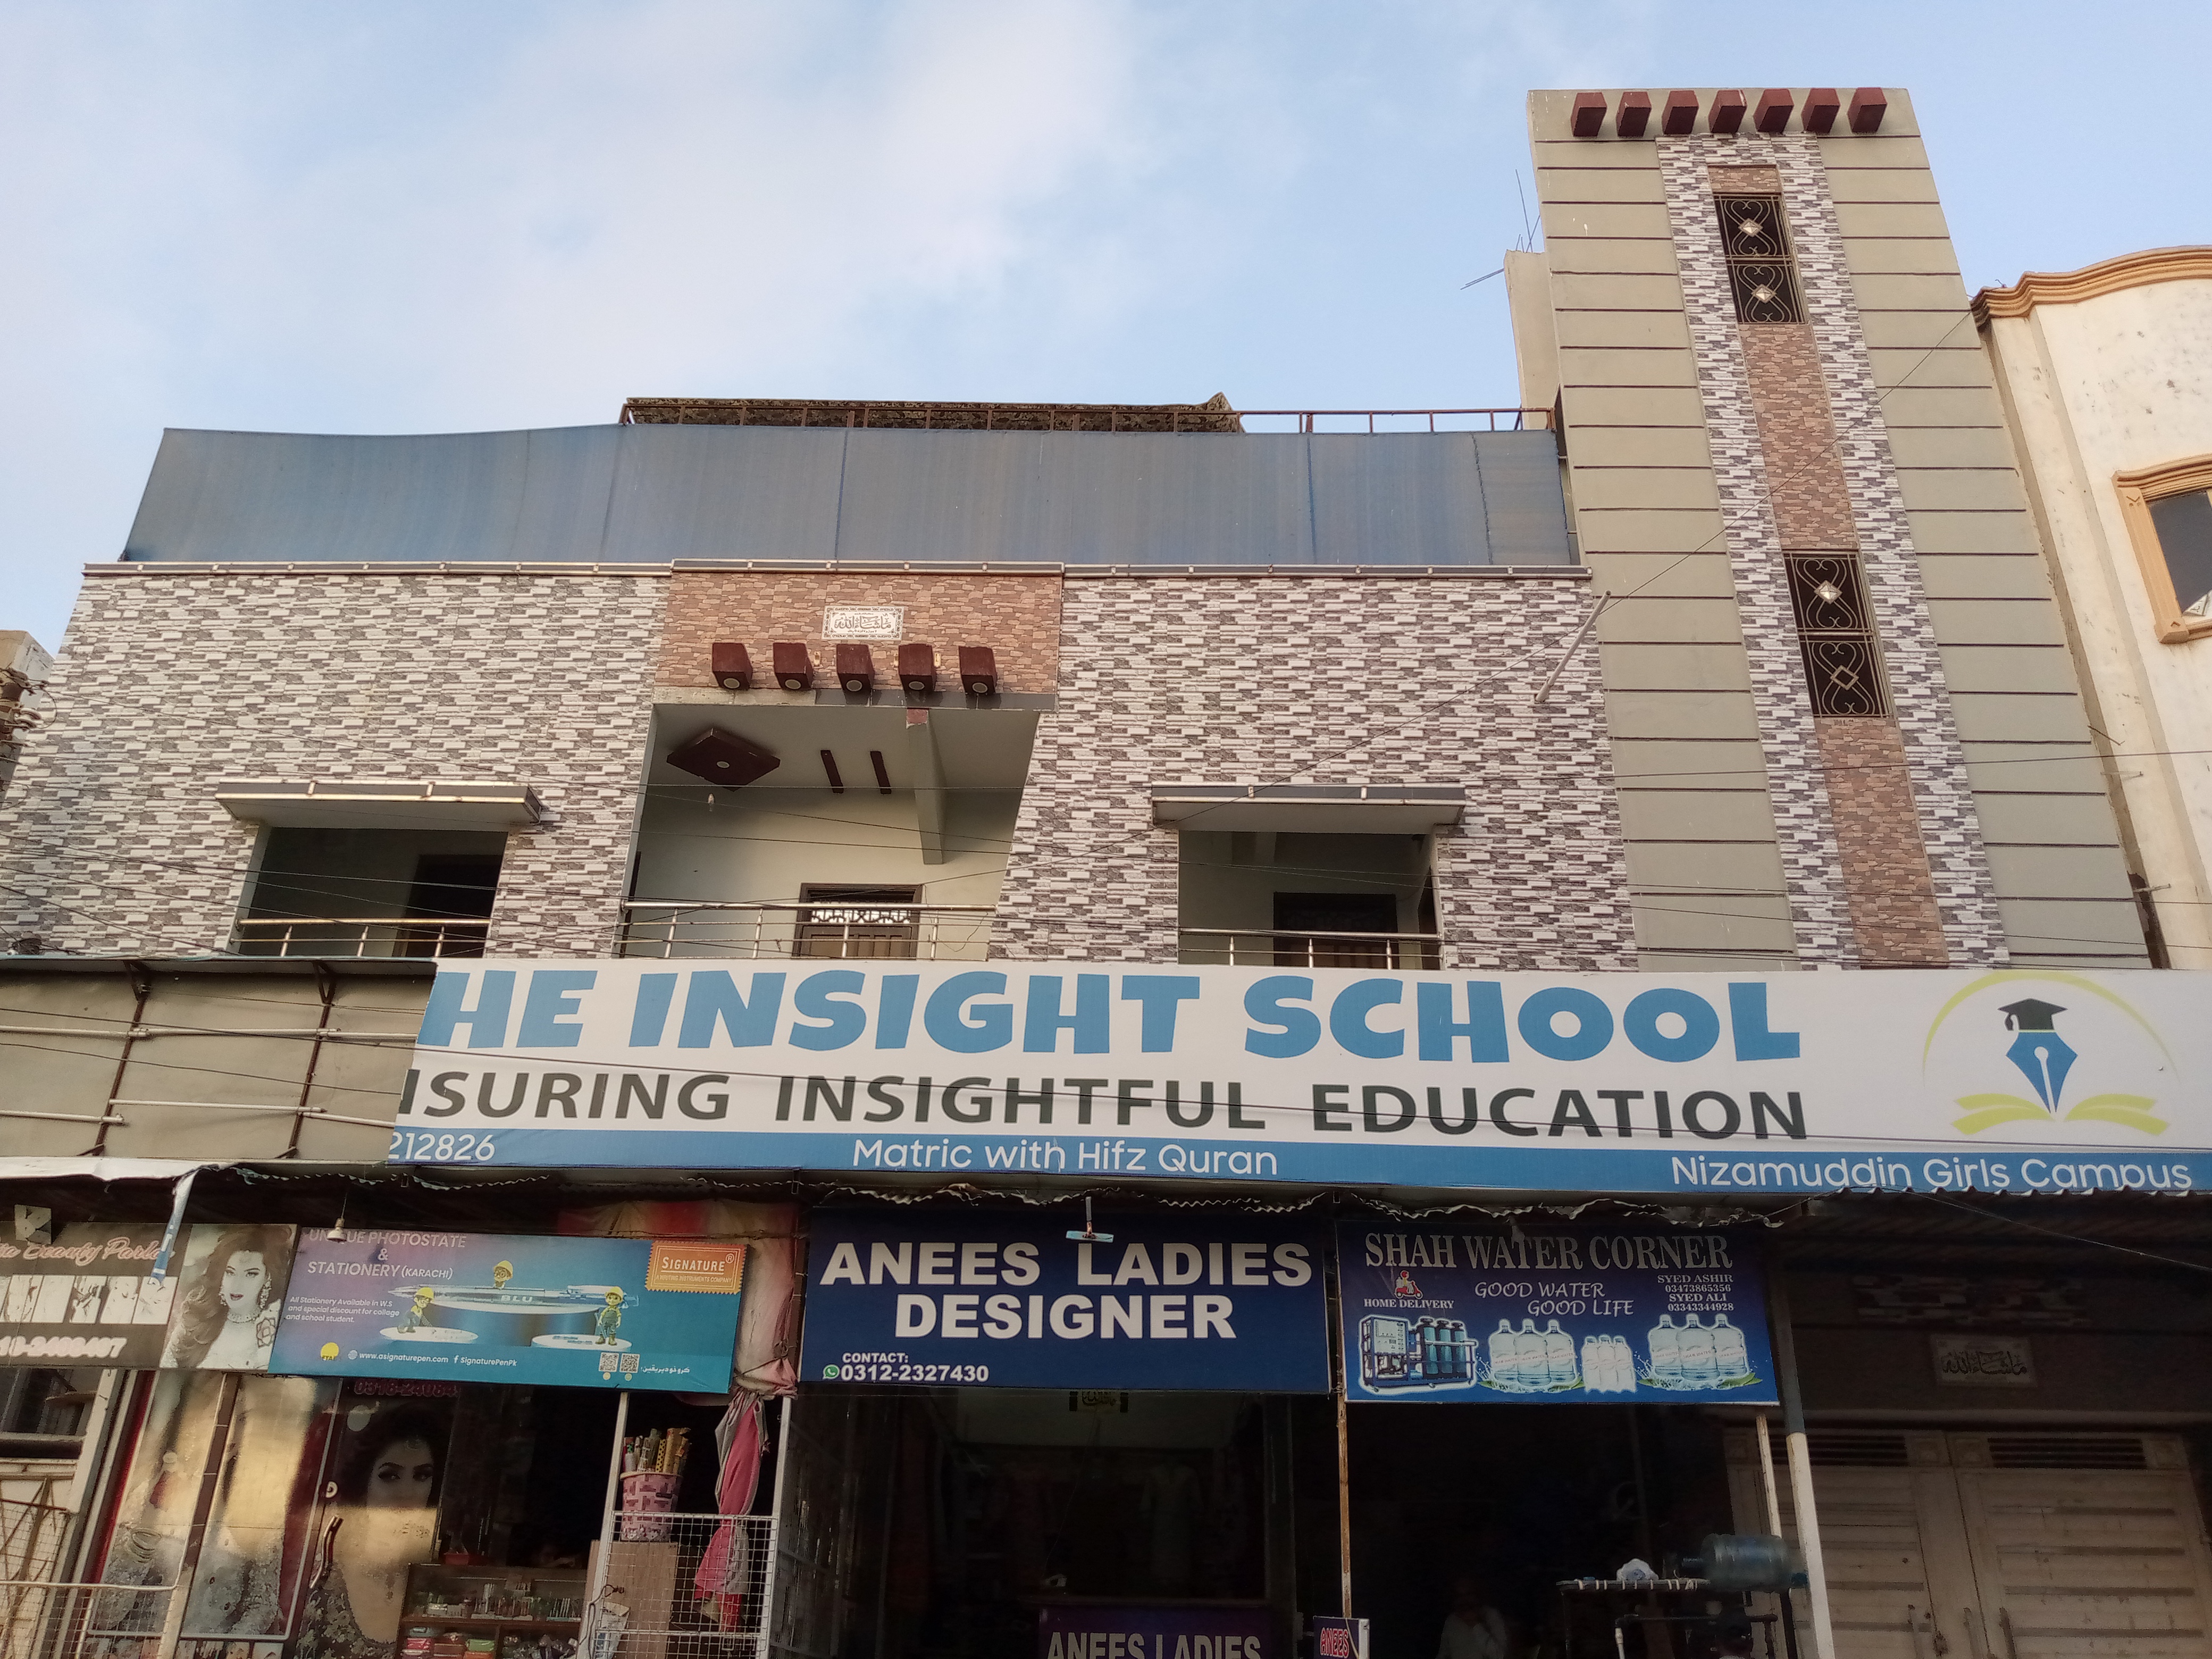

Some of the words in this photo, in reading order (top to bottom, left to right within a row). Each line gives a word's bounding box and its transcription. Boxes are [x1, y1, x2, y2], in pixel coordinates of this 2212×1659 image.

[629, 969, 1200, 1054] INSIGHT
[1243, 975, 1800, 1063] SCHOOL
[775, 1075, 1266, 1129] INSIGHTFUL
[1312, 1084, 1807, 1140] EDUCATION
[852, 1138, 973, 1169] Matric
[984, 1138, 1067, 1172] with
[1077, 1140, 1153, 1173] Hifz
[1159, 1143, 1278, 1178] Quran
[1672, 1155, 1912, 1189] Nizamuddin
[1923, 1157, 2010, 1189] Girls
[2021, 1158, 2193, 1193] Campus
[367, 1231, 467, 1248] PHOTOSTATE
[376, 1247, 389, 1261] &
[1365, 1233, 1457, 1268] SHAH
[1463, 1234, 1583, 1270] WATER
[1589, 1235, 1733, 1270] CORNER
[307, 1261, 400, 1277] STATIONERY
[401, 1266, 454, 1280] (KARACHI)
[661, 1256, 725, 1272] SIGNATURE
[820, 1243, 1040, 1286] ANEES
[1077, 1243, 1312, 1286] LADIES
[1657, 1275, 1691, 1283] SYED
[1694, 1273, 1733, 1283] ASHIR
[1474, 1281, 1534, 1298] GOOD
[1538, 1281, 1605, 1298] WATER
[1665, 1284, 1731, 1293] 03473865356
[1669, 1293, 1703, 1302] SYED
[1706, 1293, 1727, 1302] ALI
[300, 1297, 337, 1306] Stationery
[1363, 1298, 1397, 1308] HOME
[1399, 1299, 1454, 1309] DELIVERY
[1527, 1300, 1586, 1317] GOOD
[1593, 1299, 1634, 1317] LIFE
[895, 1294, 1237, 1339] DESIGNER
[842, 1352, 909, 1364] CONTACT:
[840, 1364, 990, 1382] 0312-2327430
[1320, 1627, 1350, 1658] ANEES
